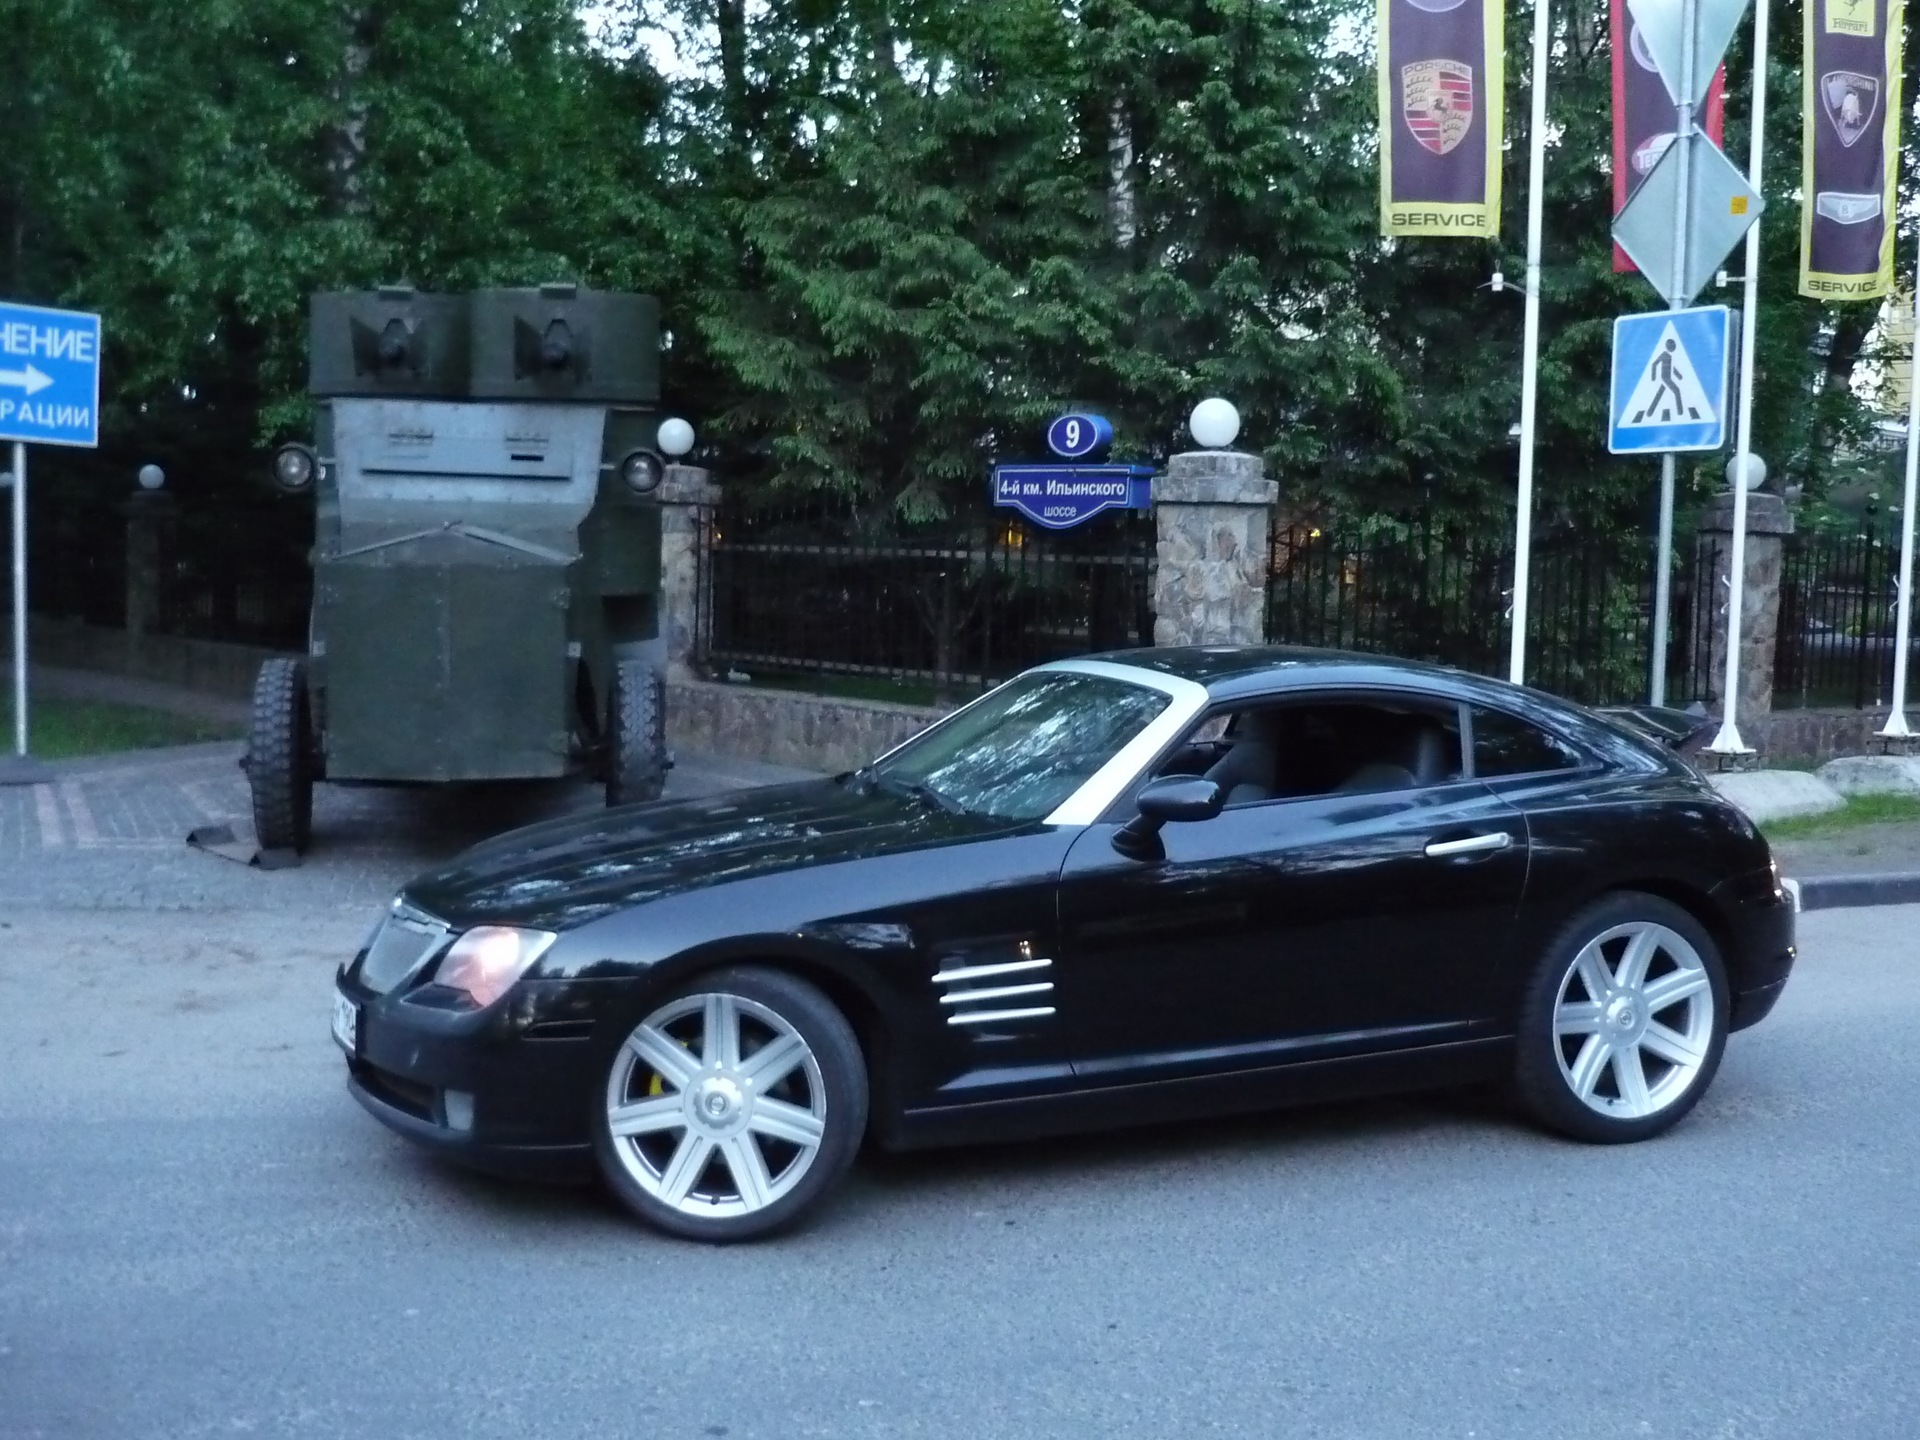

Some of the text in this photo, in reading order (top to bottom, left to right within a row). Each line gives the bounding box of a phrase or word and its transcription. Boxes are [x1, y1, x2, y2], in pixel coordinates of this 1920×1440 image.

[1833, 17, 1868, 32] Ferrari
[1391, 212, 1486, 228] SERVICE
[0, 399, 89, 429] РАЦИИ
[1065, 420, 1080, 448] 9
[1000, 479, 1125, 496] 4-й км. Ильинского
[1044, 505, 1077, 517] шоссе
